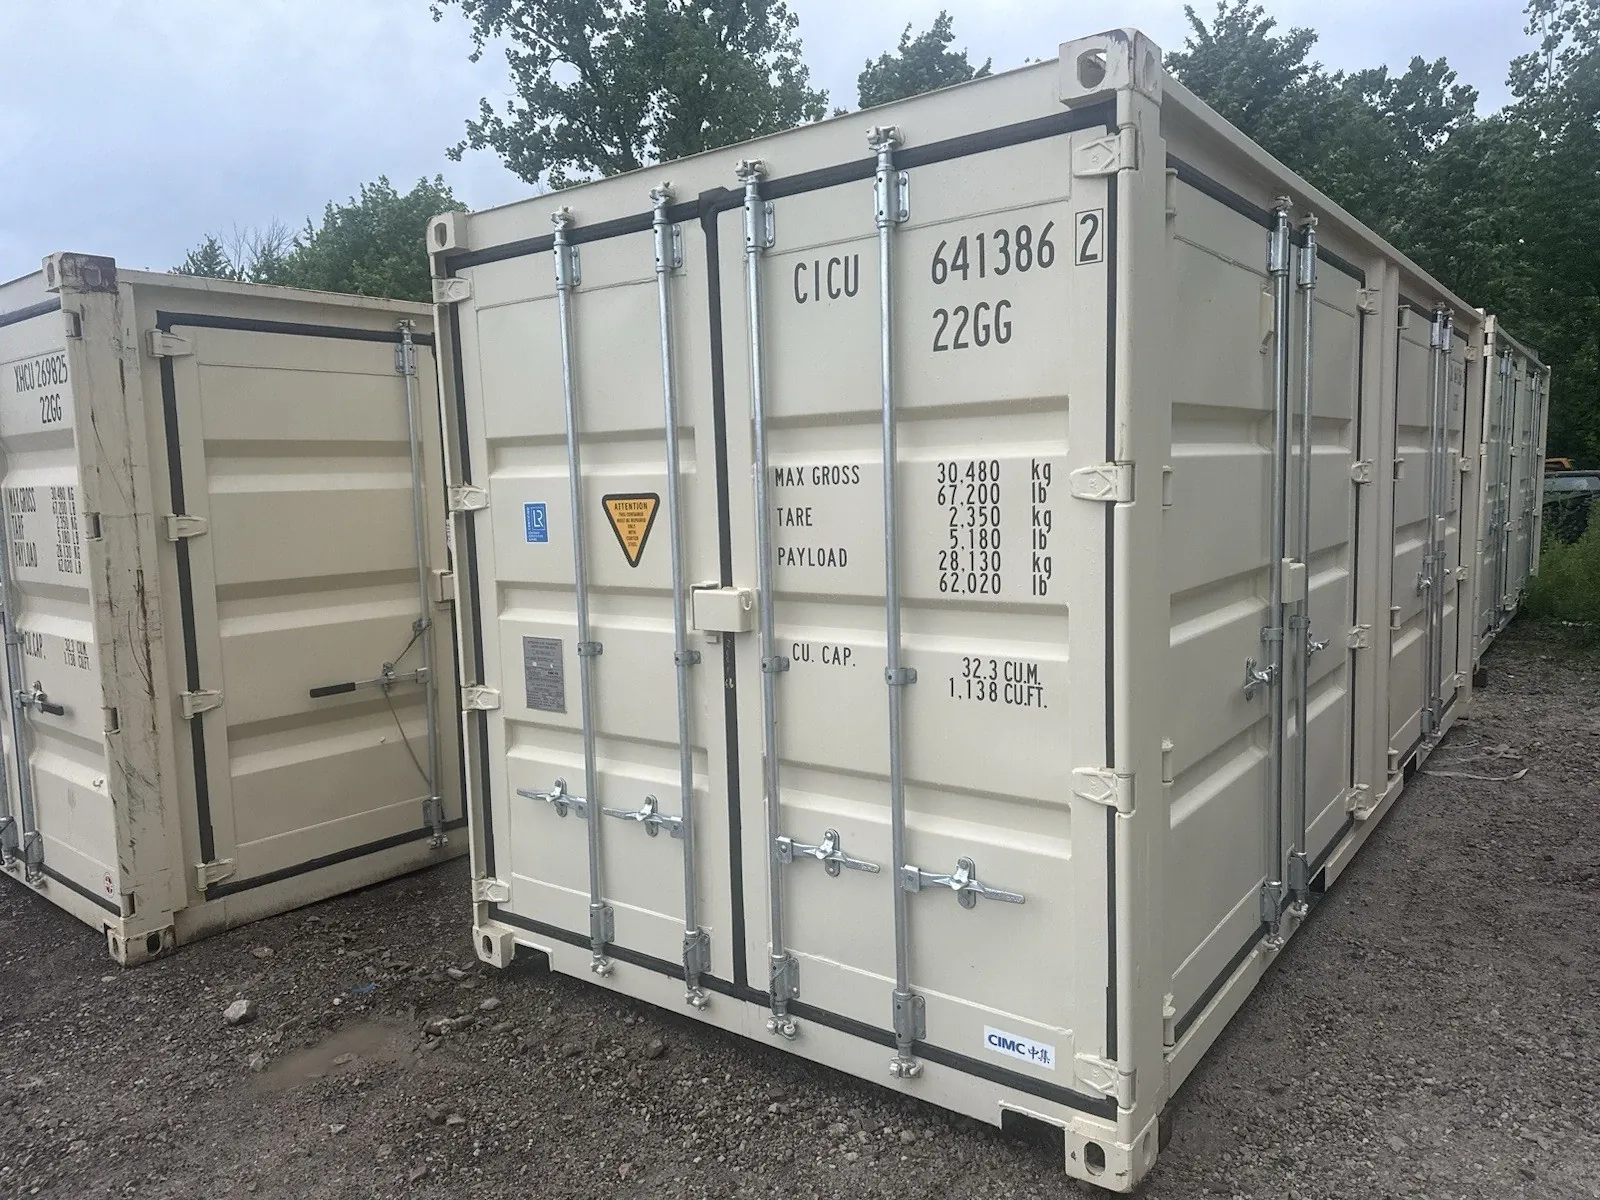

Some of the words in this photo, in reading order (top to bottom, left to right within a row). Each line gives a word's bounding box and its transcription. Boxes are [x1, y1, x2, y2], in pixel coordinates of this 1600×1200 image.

[794, 254, 859, 304] CICU
[932, 221, 1055, 285] 641386
[1079, 213, 1099, 263] 2
[932, 299, 1012, 352] 22GG
[14, 362, 35, 393] XHCU
[35, 354, 68, 388] 269825
[40, 393, 62, 424] 22GG
[775, 467, 805, 487] MAX
[812, 465, 860, 486] GROSS
[937, 459, 1000, 485] 30,480
[1032, 458, 1051, 487] kg
[614, 502, 648, 510] ATTENTION
[938, 483, 1000, 506] 67,200
[1032, 482, 1047, 504] lb
[777, 507, 813, 527] TARE
[949, 505, 1000, 529] 2,350
[1032, 505, 1052, 534] kg
[950, 528, 1001, 551] 5,180
[1032, 528, 1047, 550] lb
[778, 547, 848, 567] PAYLOAD
[939, 550, 1001, 573] 28,130
[1033, 551, 1052, 580] kg
[939, 572, 1001, 594] 62,020
[1033, 574, 1047, 596] lb
[793, 643, 814, 663] CU.
[822, 645, 856, 667] CAP.
[962, 657, 997, 681] 32.3
[1004, 661, 1041, 685] CU.M.
[949, 677, 998, 702] 1,138
[1004, 683, 1047, 708] CU.FT.
[988, 1034, 1026, 1055] CIMC
